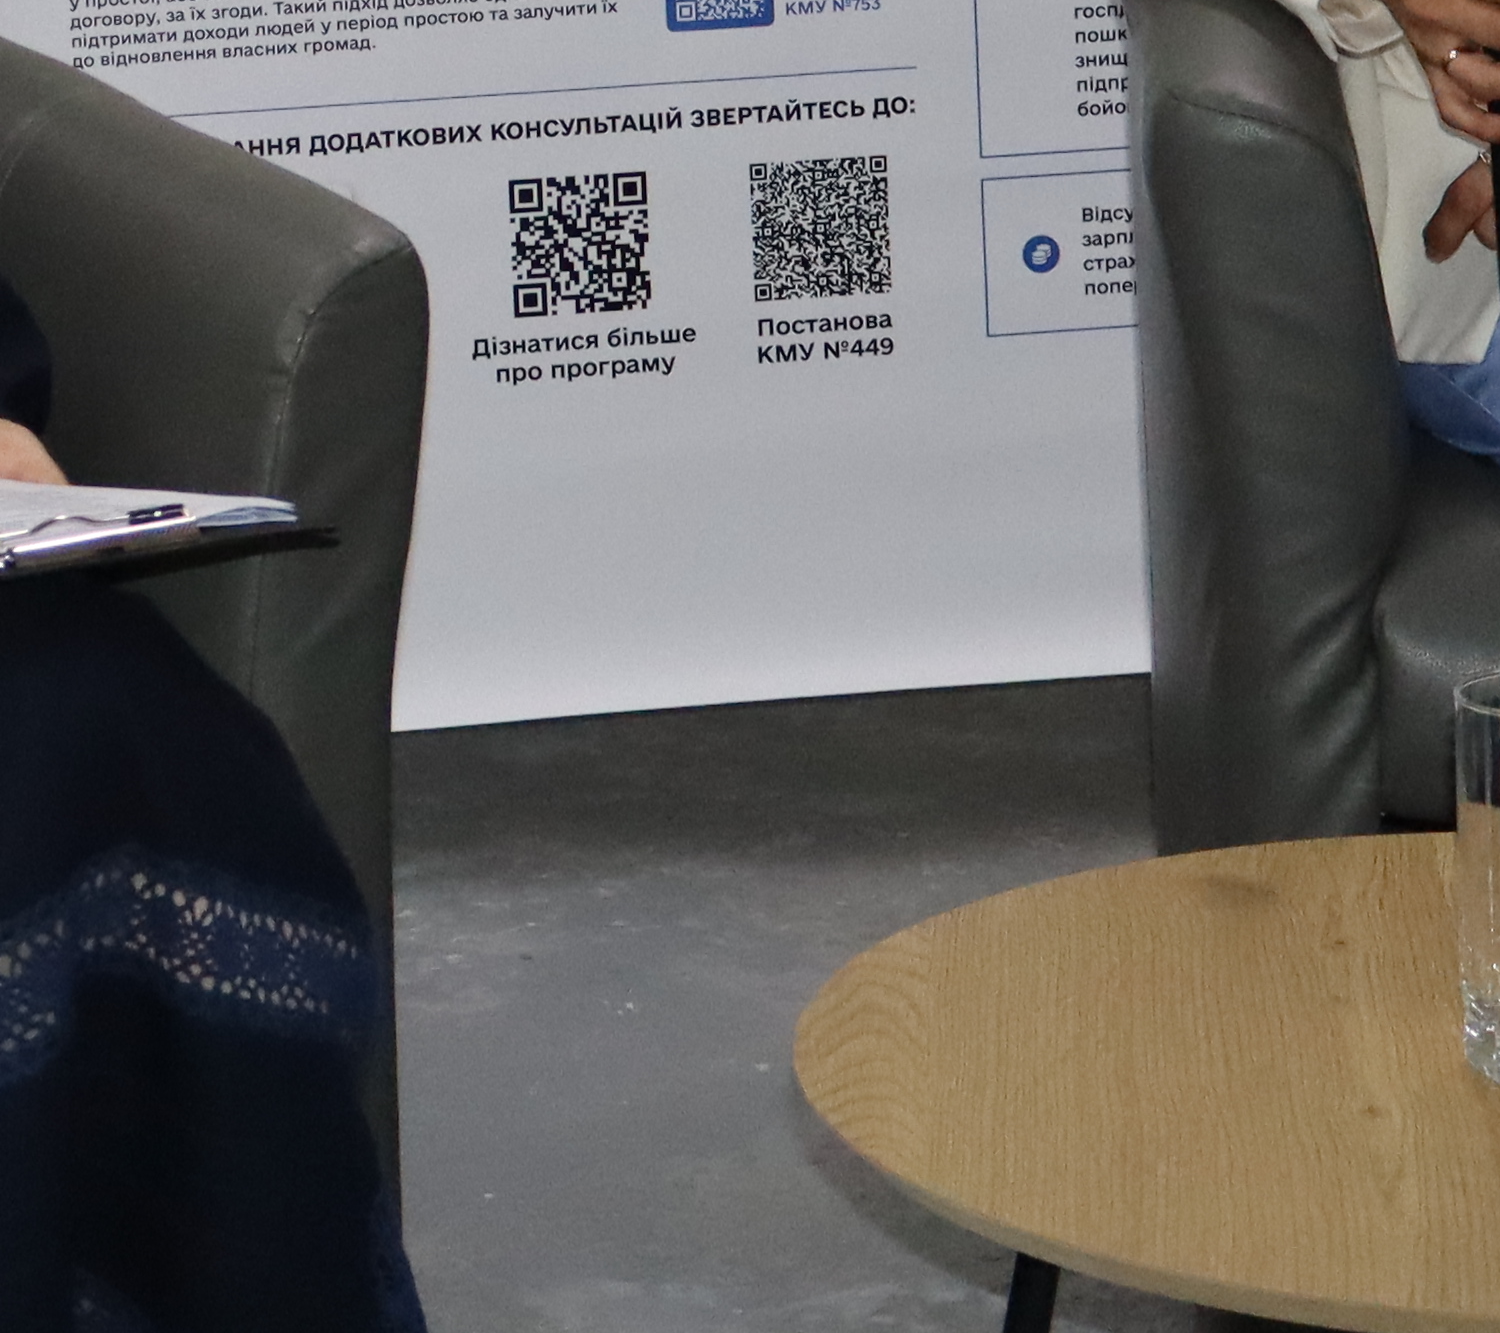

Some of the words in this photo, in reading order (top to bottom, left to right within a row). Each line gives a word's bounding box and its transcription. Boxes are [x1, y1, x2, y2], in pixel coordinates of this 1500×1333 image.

[758, 314, 892, 336] Постанова
[472, 334, 598, 360] Дізнатися
[607, 328, 696, 347] більше
[758, 343, 814, 363] КМУ
[824, 337, 894, 359] №449
[496, 366, 542, 385] про
[551, 357, 675, 382] програму
